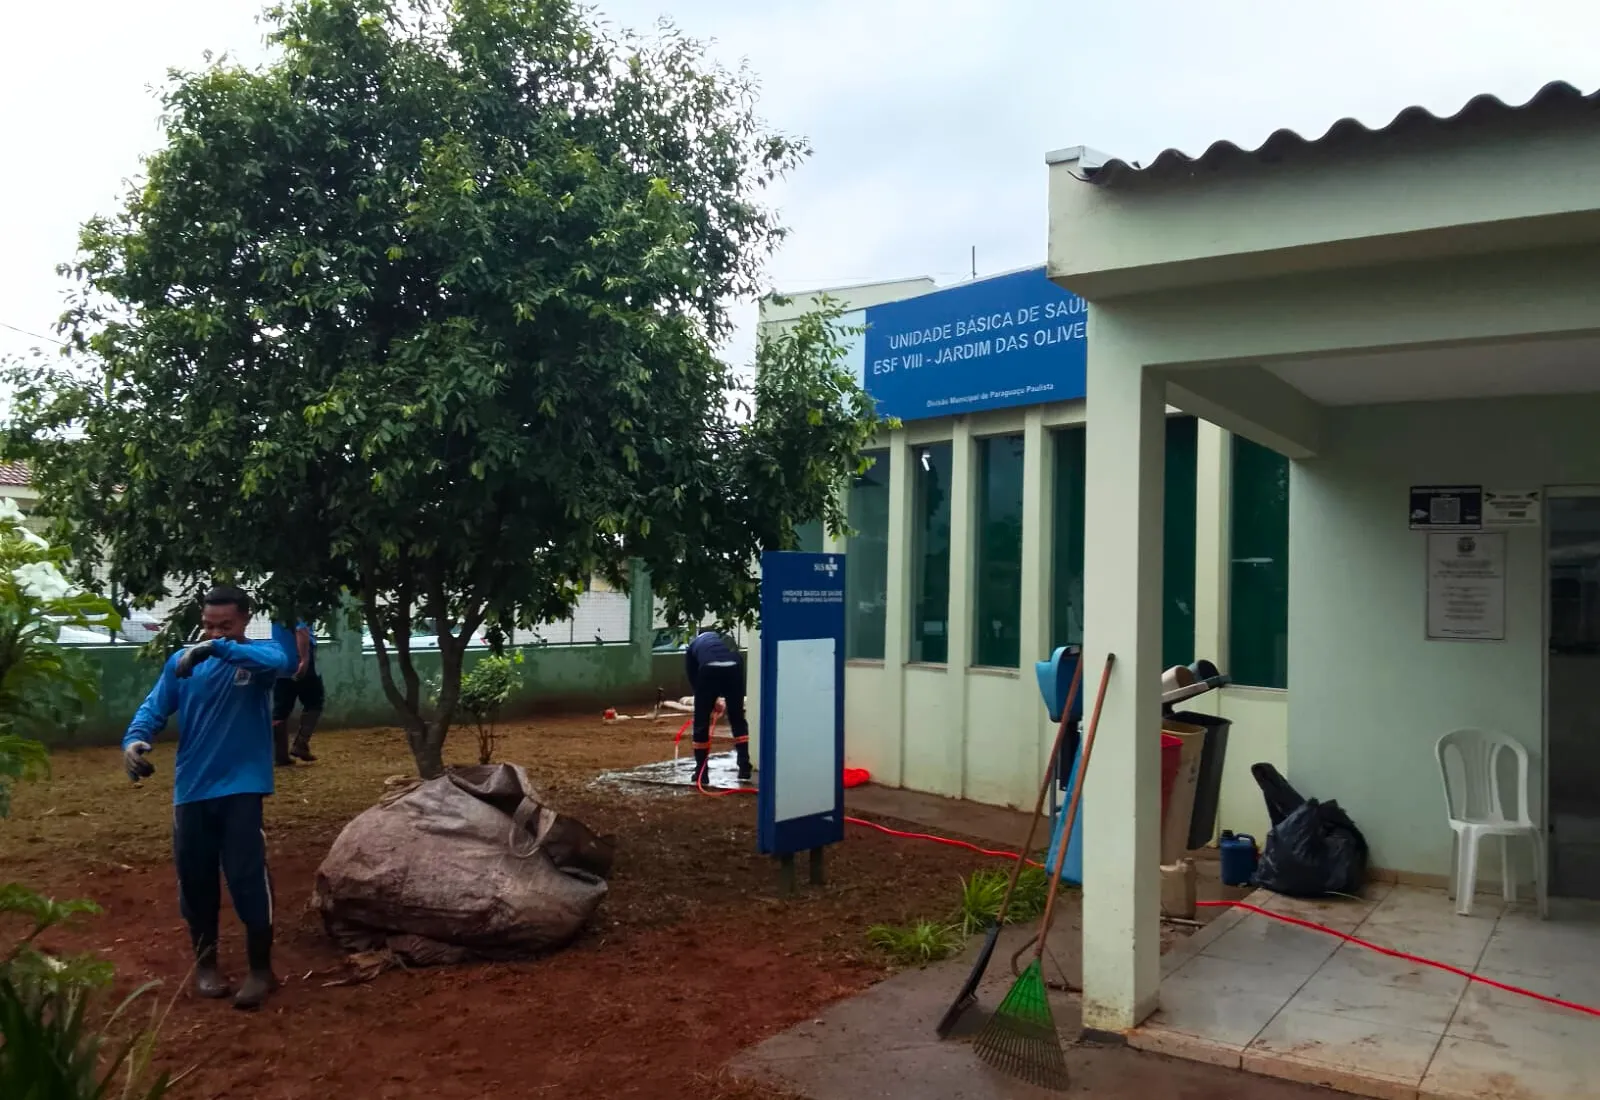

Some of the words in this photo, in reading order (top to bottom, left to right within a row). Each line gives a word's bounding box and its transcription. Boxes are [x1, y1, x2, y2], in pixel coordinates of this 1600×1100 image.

[890, 323, 952, 350] UNIDADE
[1017, 305, 1040, 325] DE
[873, 356, 899, 375] ESF
[902, 353, 923, 370] VIII
[934, 340, 991, 365] JARDIM
[995, 333, 1029, 354] DAS
